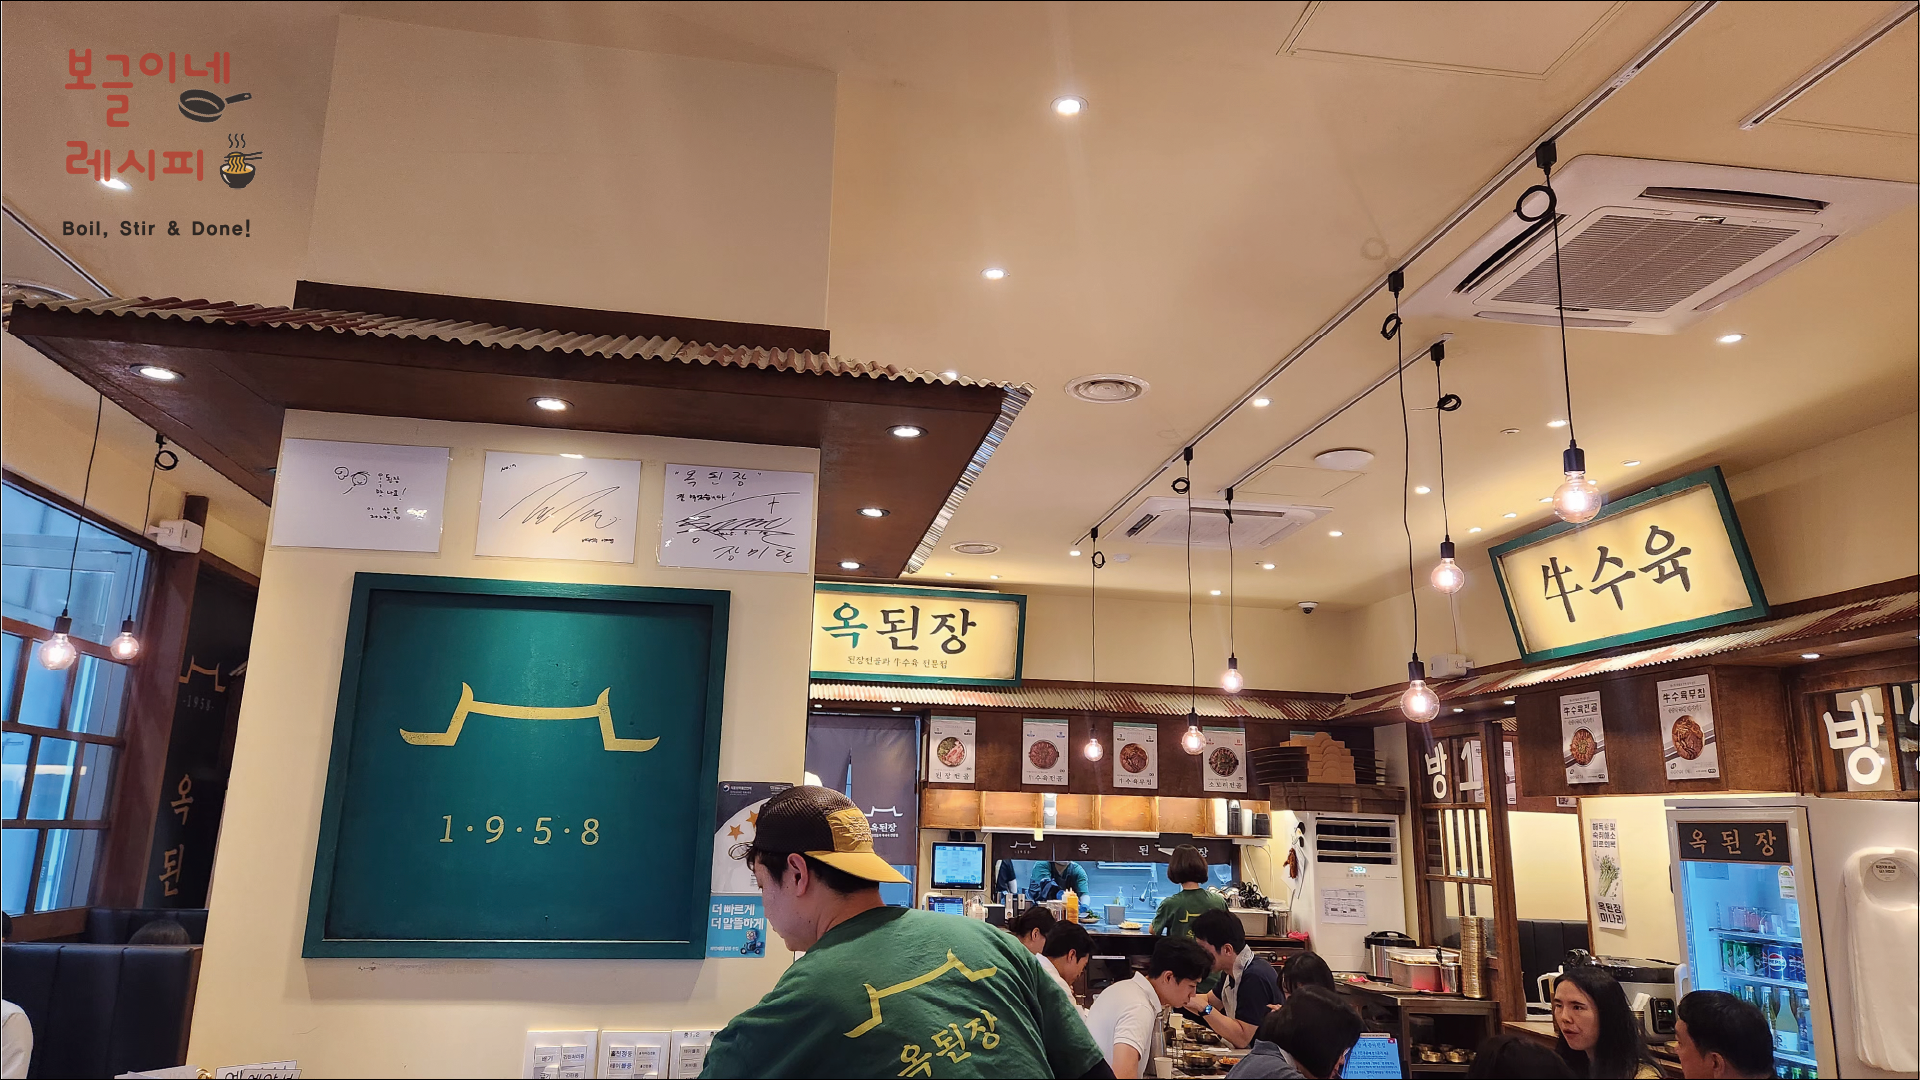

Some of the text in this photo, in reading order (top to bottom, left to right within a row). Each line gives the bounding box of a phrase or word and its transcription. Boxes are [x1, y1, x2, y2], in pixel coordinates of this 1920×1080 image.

[1541, 525, 1692, 623] 牛수육
[821, 602, 977, 654] 옥된장
[922, 658, 948, 669] 전문점
[870, 822, 898, 833] 옥된장
[1688, 828, 1777, 857] 옥된장
[712, 903, 756, 916] 더 빠르게
[1598, 901, 1622, 914] 옥된장
[711, 917, 765, 930] 더 알뜰하게
[1600, 912, 1625, 925] 미나리
[897, 1009, 1001, 1078] 옥된장
